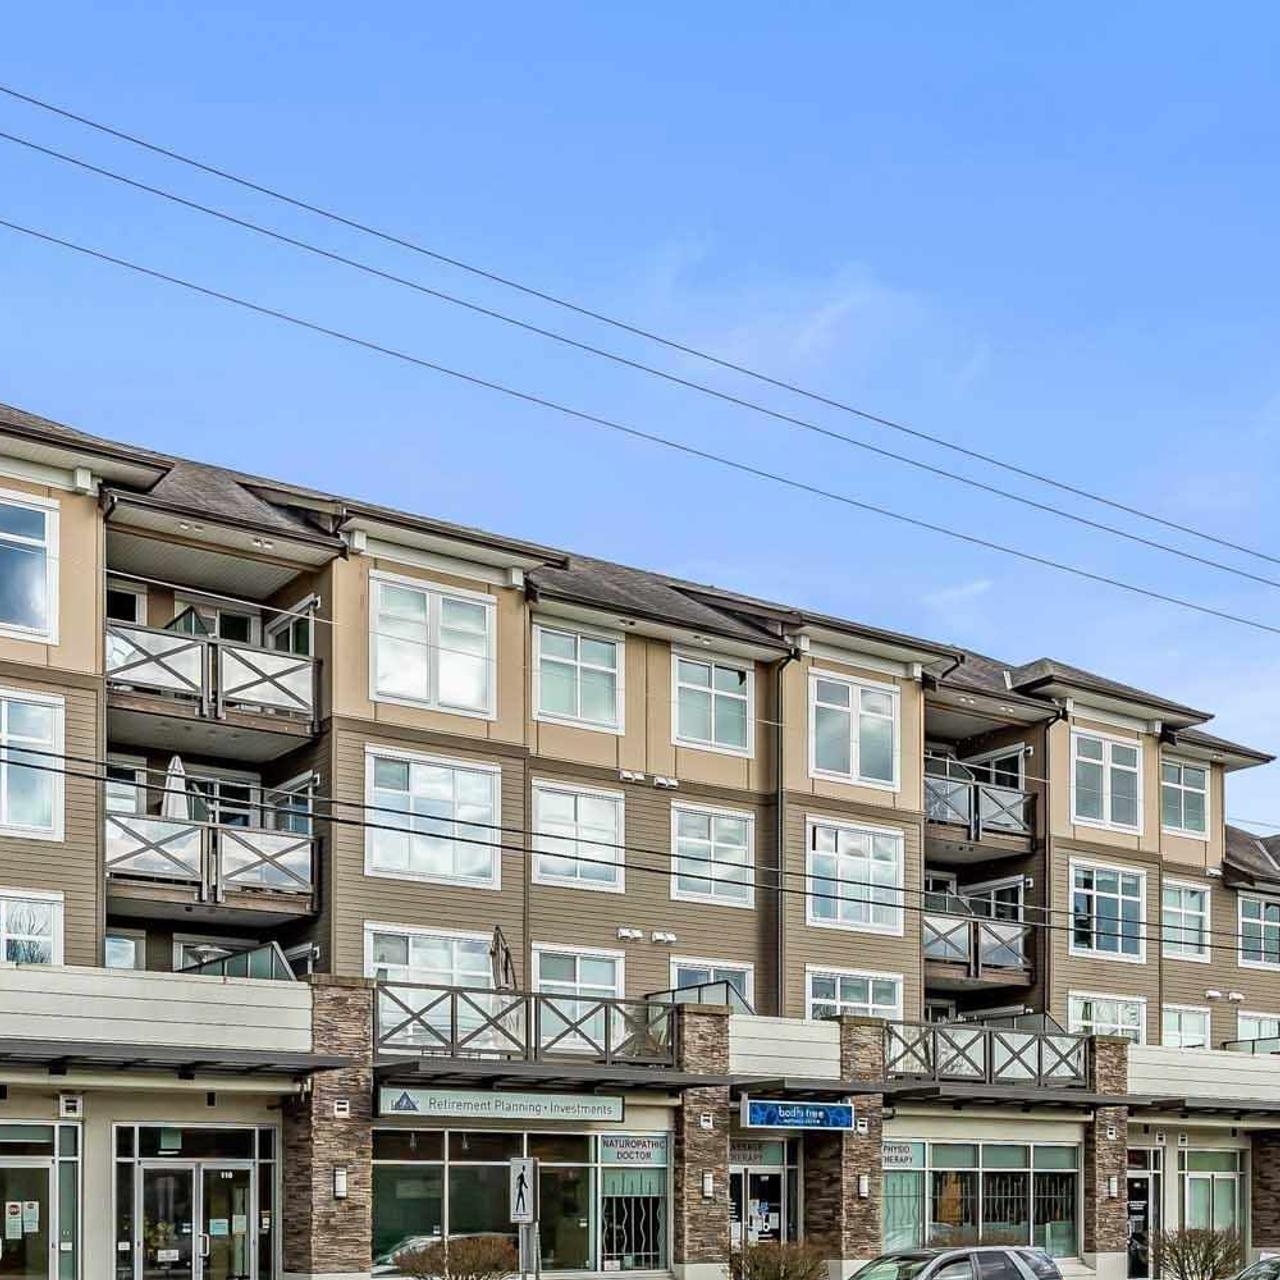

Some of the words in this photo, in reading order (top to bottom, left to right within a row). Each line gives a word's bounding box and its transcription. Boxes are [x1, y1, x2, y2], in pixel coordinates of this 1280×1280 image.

[428, 1097, 491, 1111] Retirement
[495, 1098, 541, 1115] Planning
[550, 1100, 613, 1115] Investments
[602, 1138, 666, 1149] NATUROPATHIC
[616, 1150, 652, 1160] DOCTOR
